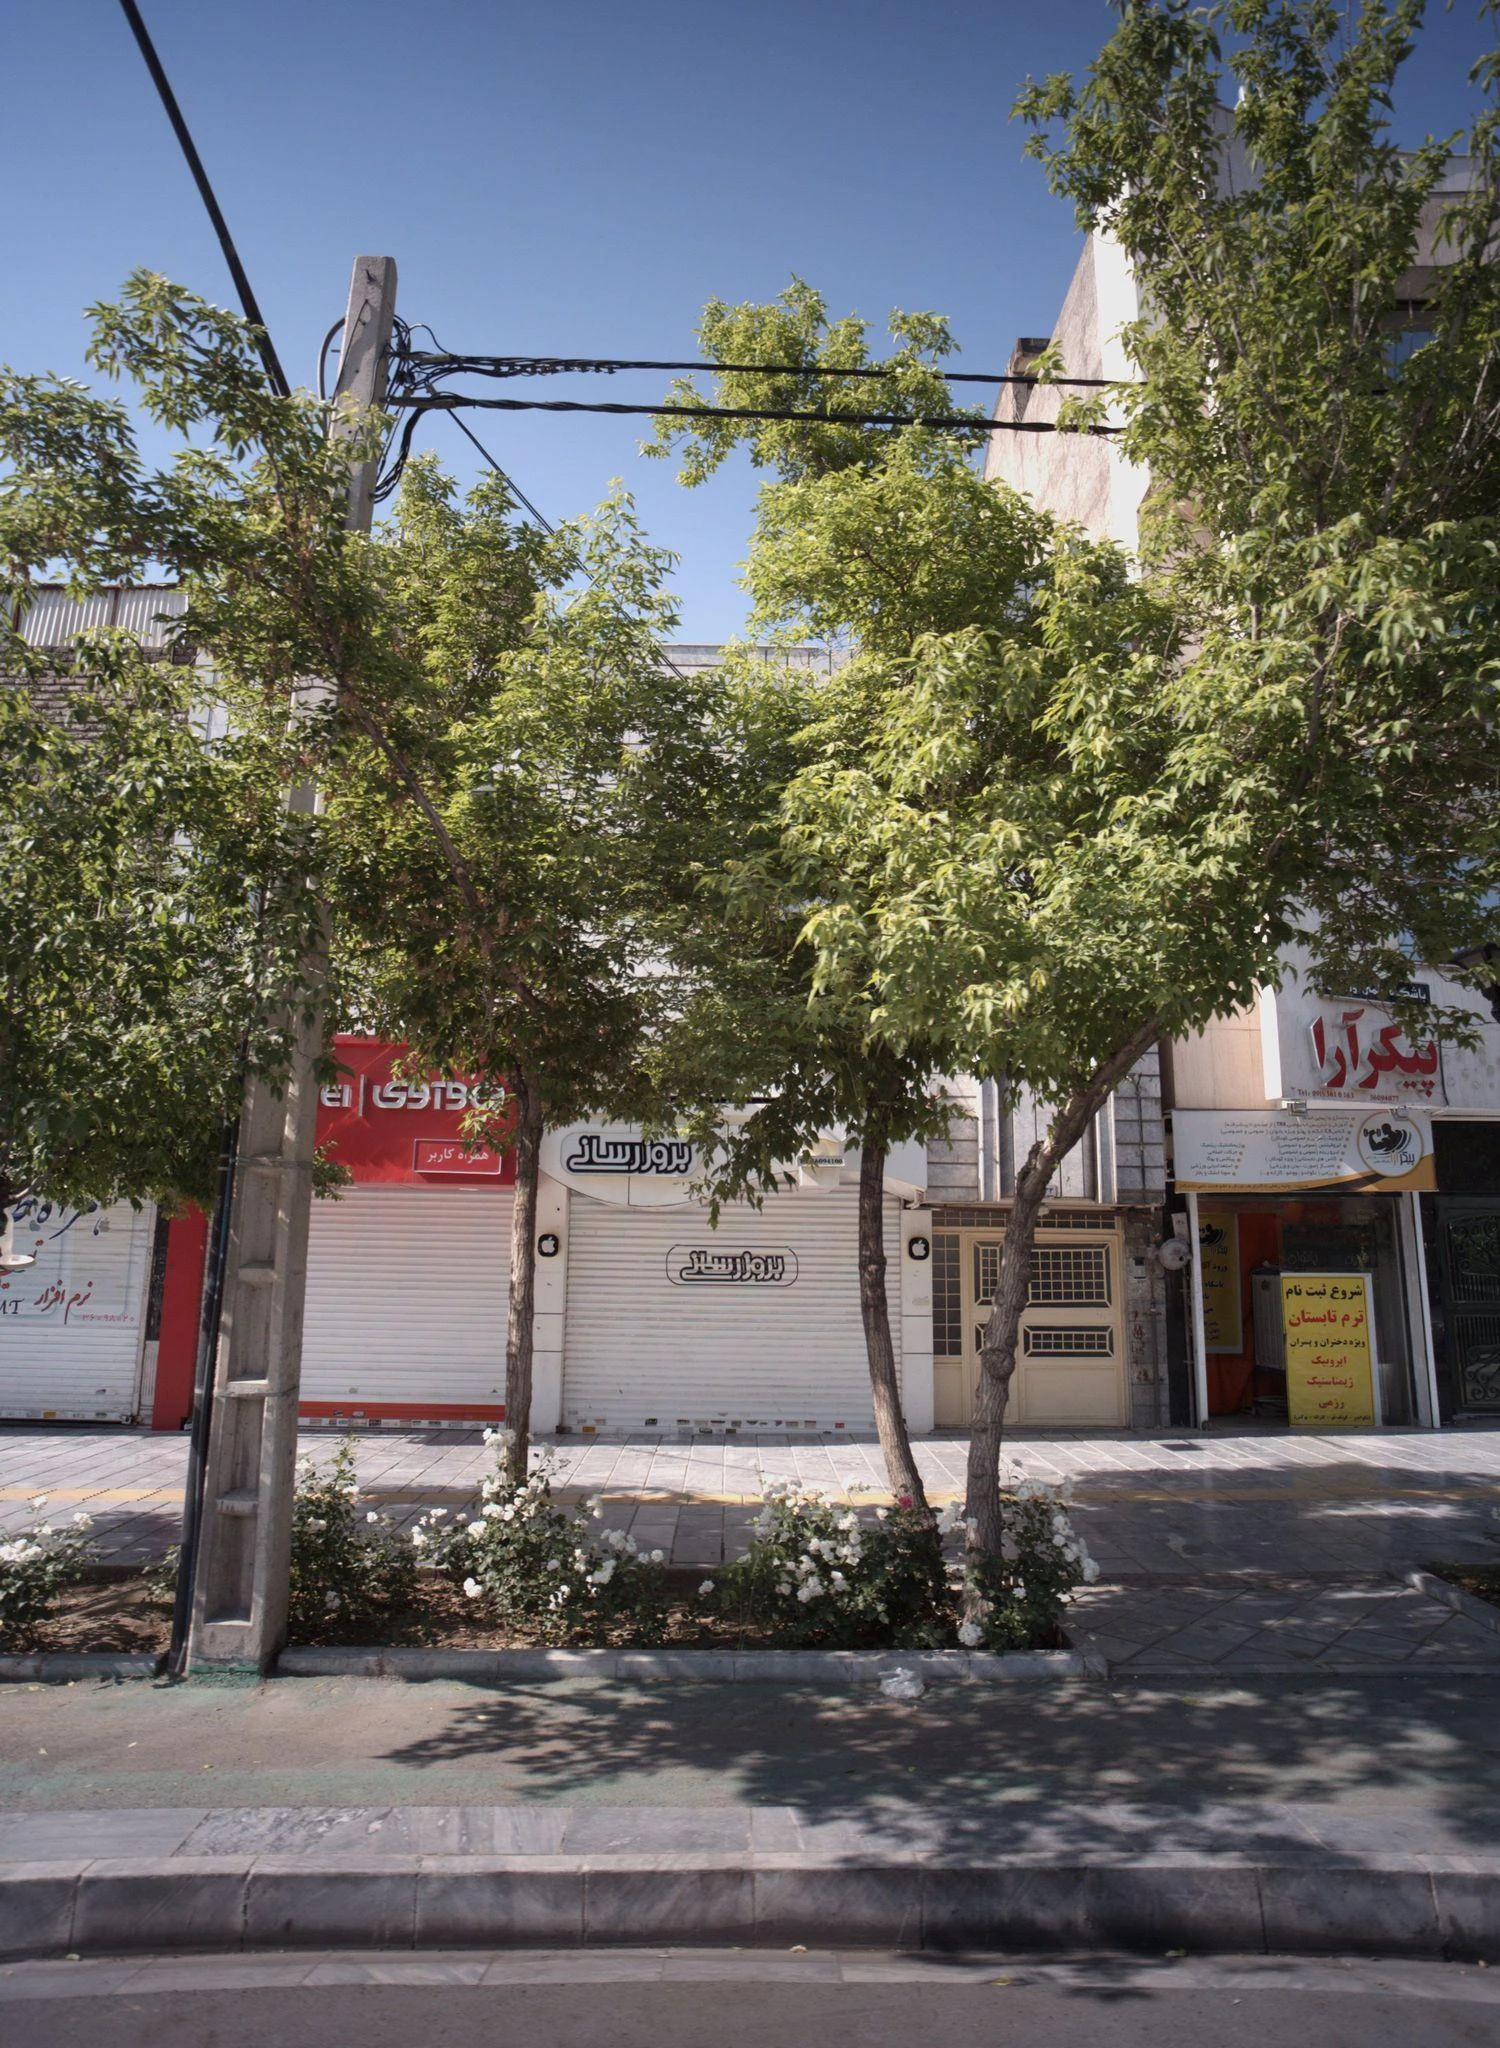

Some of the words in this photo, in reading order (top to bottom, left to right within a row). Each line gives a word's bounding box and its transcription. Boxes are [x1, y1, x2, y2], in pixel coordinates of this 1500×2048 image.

[426, 1149, 454, 1164] کاربر
[457, 1150, 489, 1164] همراه
[33, 1279, 66, 1313] افزار
[1286, 1284, 1303, 1300] نام
[1306, 1283, 1327, 1299] ثبت
[1330, 1284, 1363, 1300] شروع
[1288, 1309, 1337, 1327] تابستان
[1341, 1309, 1364, 1328] ترم
[1290, 1337, 1312, 1349] پسران
[1319, 1337, 1348, 1348] دختران
[1348, 1338, 1366, 1348] ویژه
[1306, 1376, 1354, 1389] ژیمناستیک
[1318, 1398, 1345, 1409] رزمی
